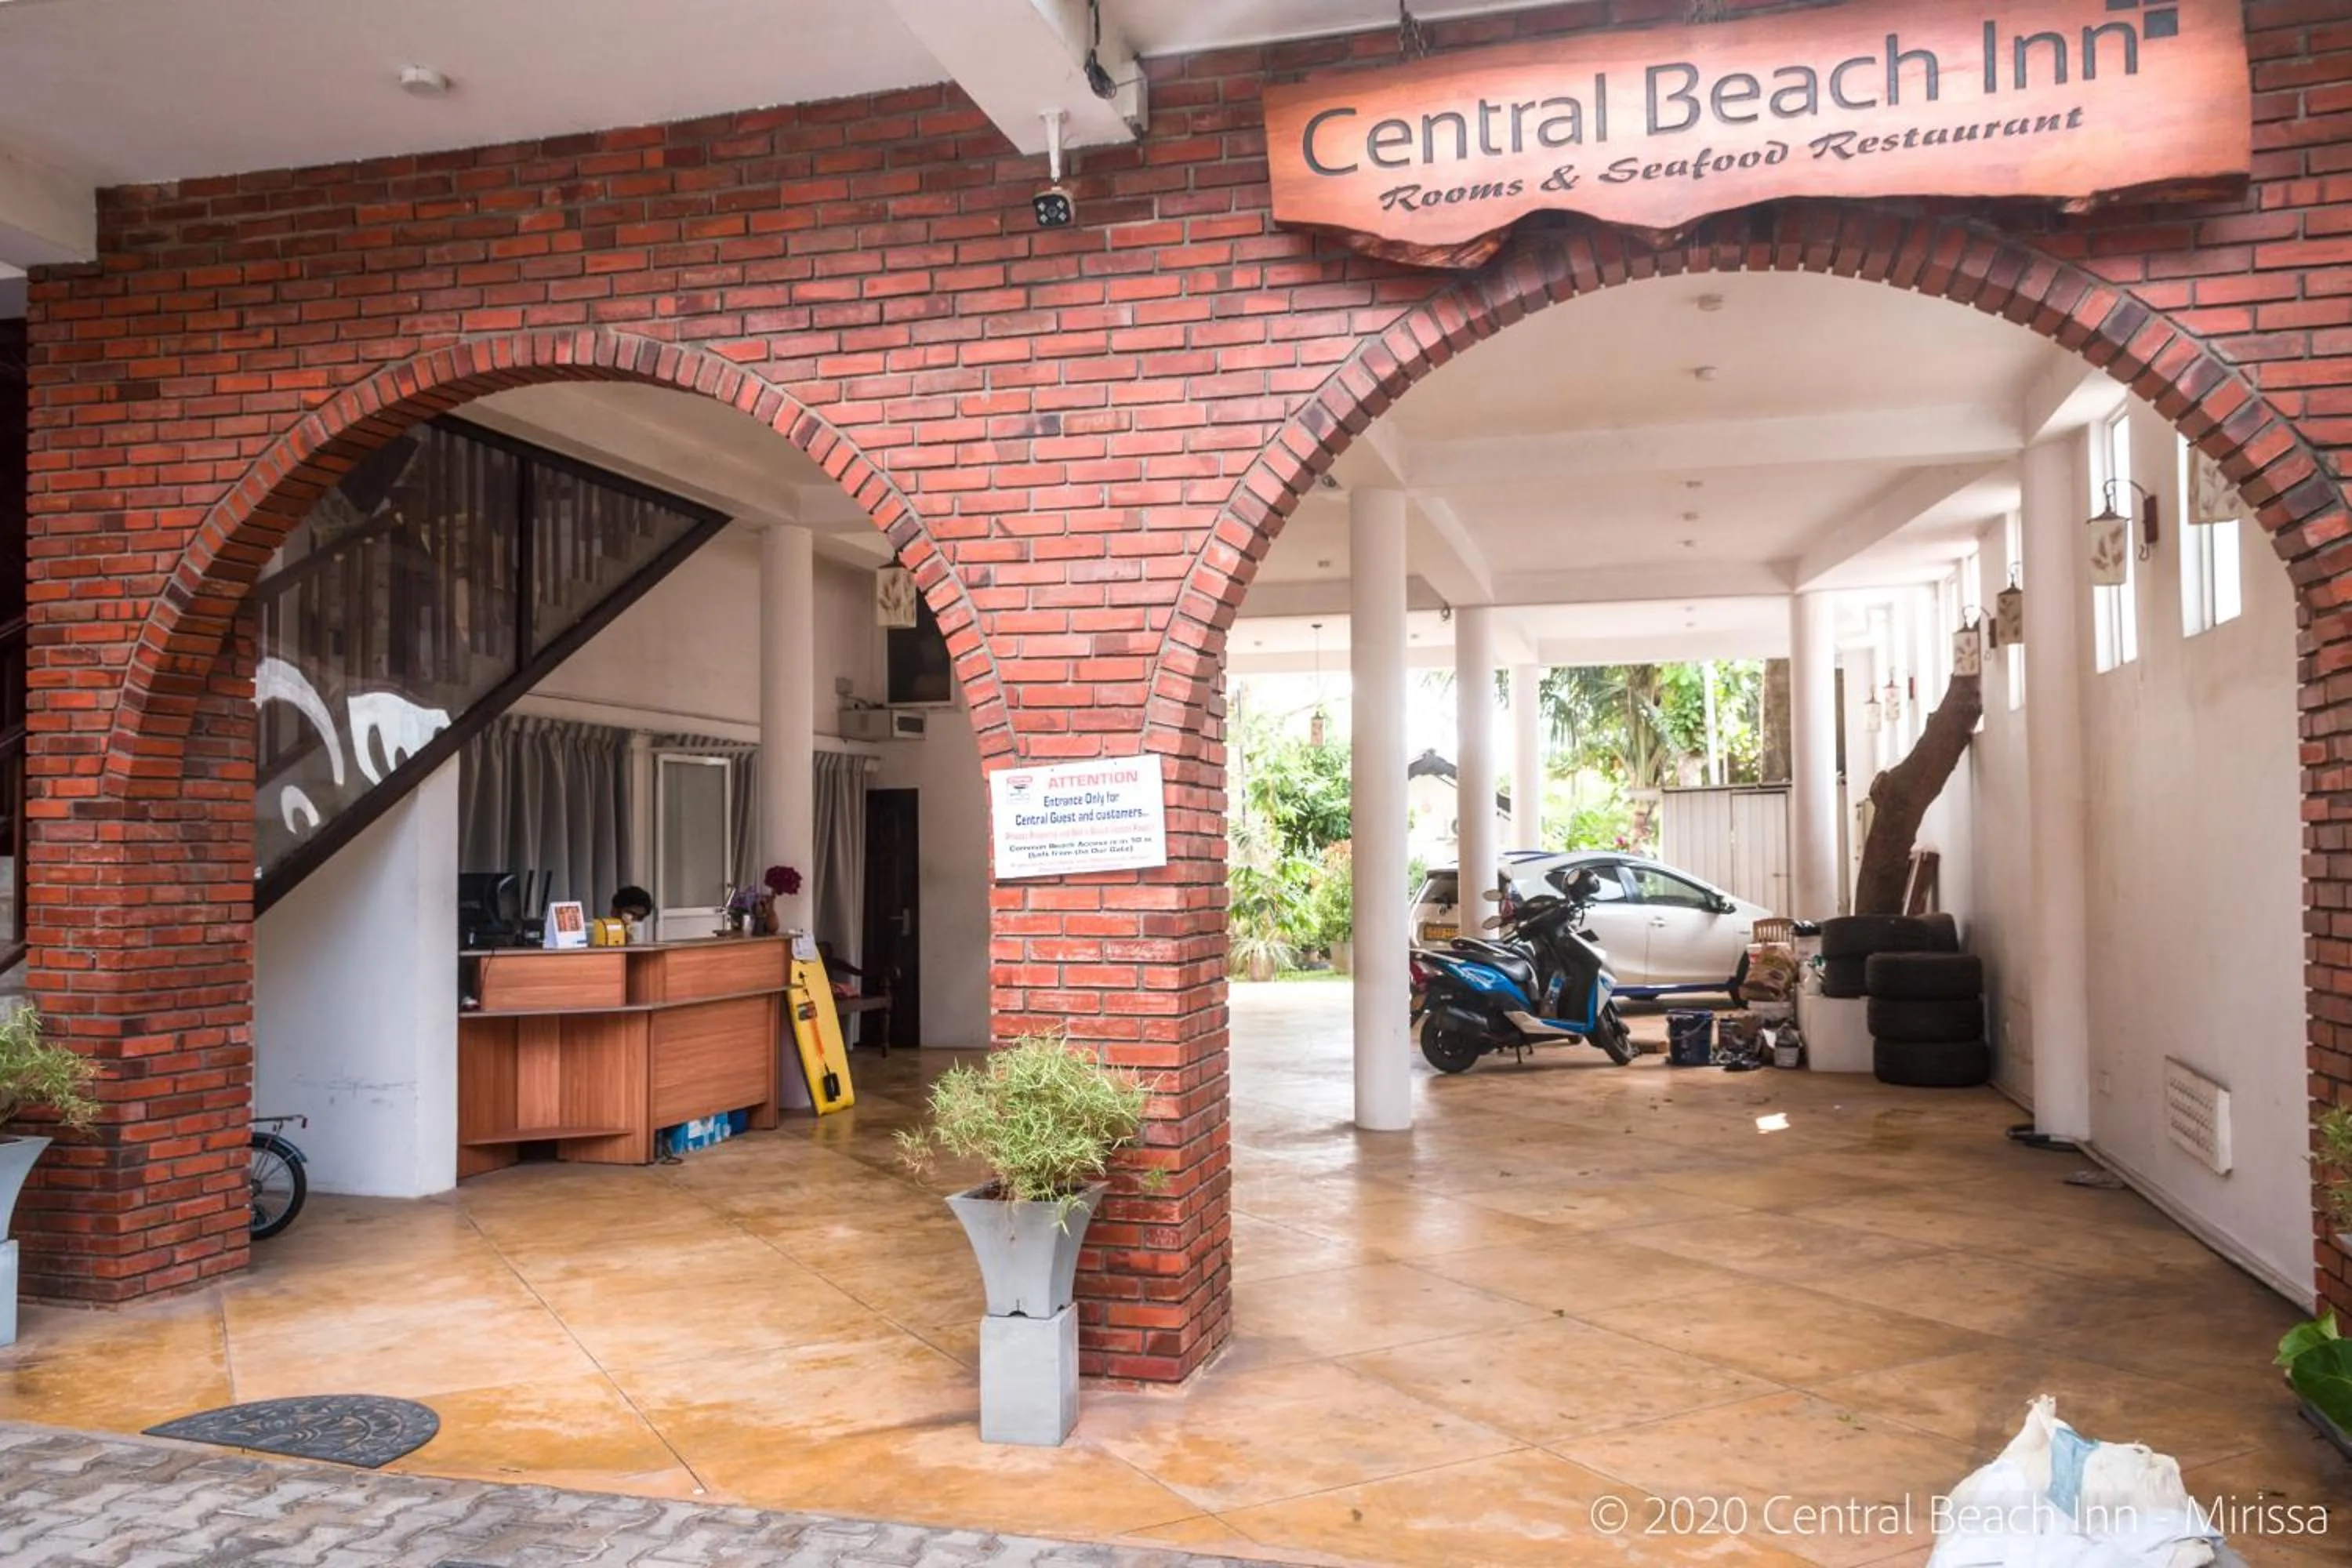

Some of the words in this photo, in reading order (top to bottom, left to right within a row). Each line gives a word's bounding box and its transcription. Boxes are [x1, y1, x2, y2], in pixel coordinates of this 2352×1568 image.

[1302, 72, 1607, 176] Central
[1645, 33, 1939, 136] Beach
[1983, 20, 2138, 93] Inn
[1378, 179, 1523, 212] Rooms
[1540, 164, 1581, 192] &
[1598, 140, 1789, 183] Seafood
[1807, 107, 2084, 161] Restaurant
[1048, 770, 1138, 789] ATTENTION
[1044, 795, 1083, 808] Entrance
[1085, 791, 1105, 806] Only
[1106, 790, 1120, 803] for
[1015, 812, 1048, 826] Central
[1051, 811, 1076, 824] Guest
[1078, 809, 1094, 822] and
